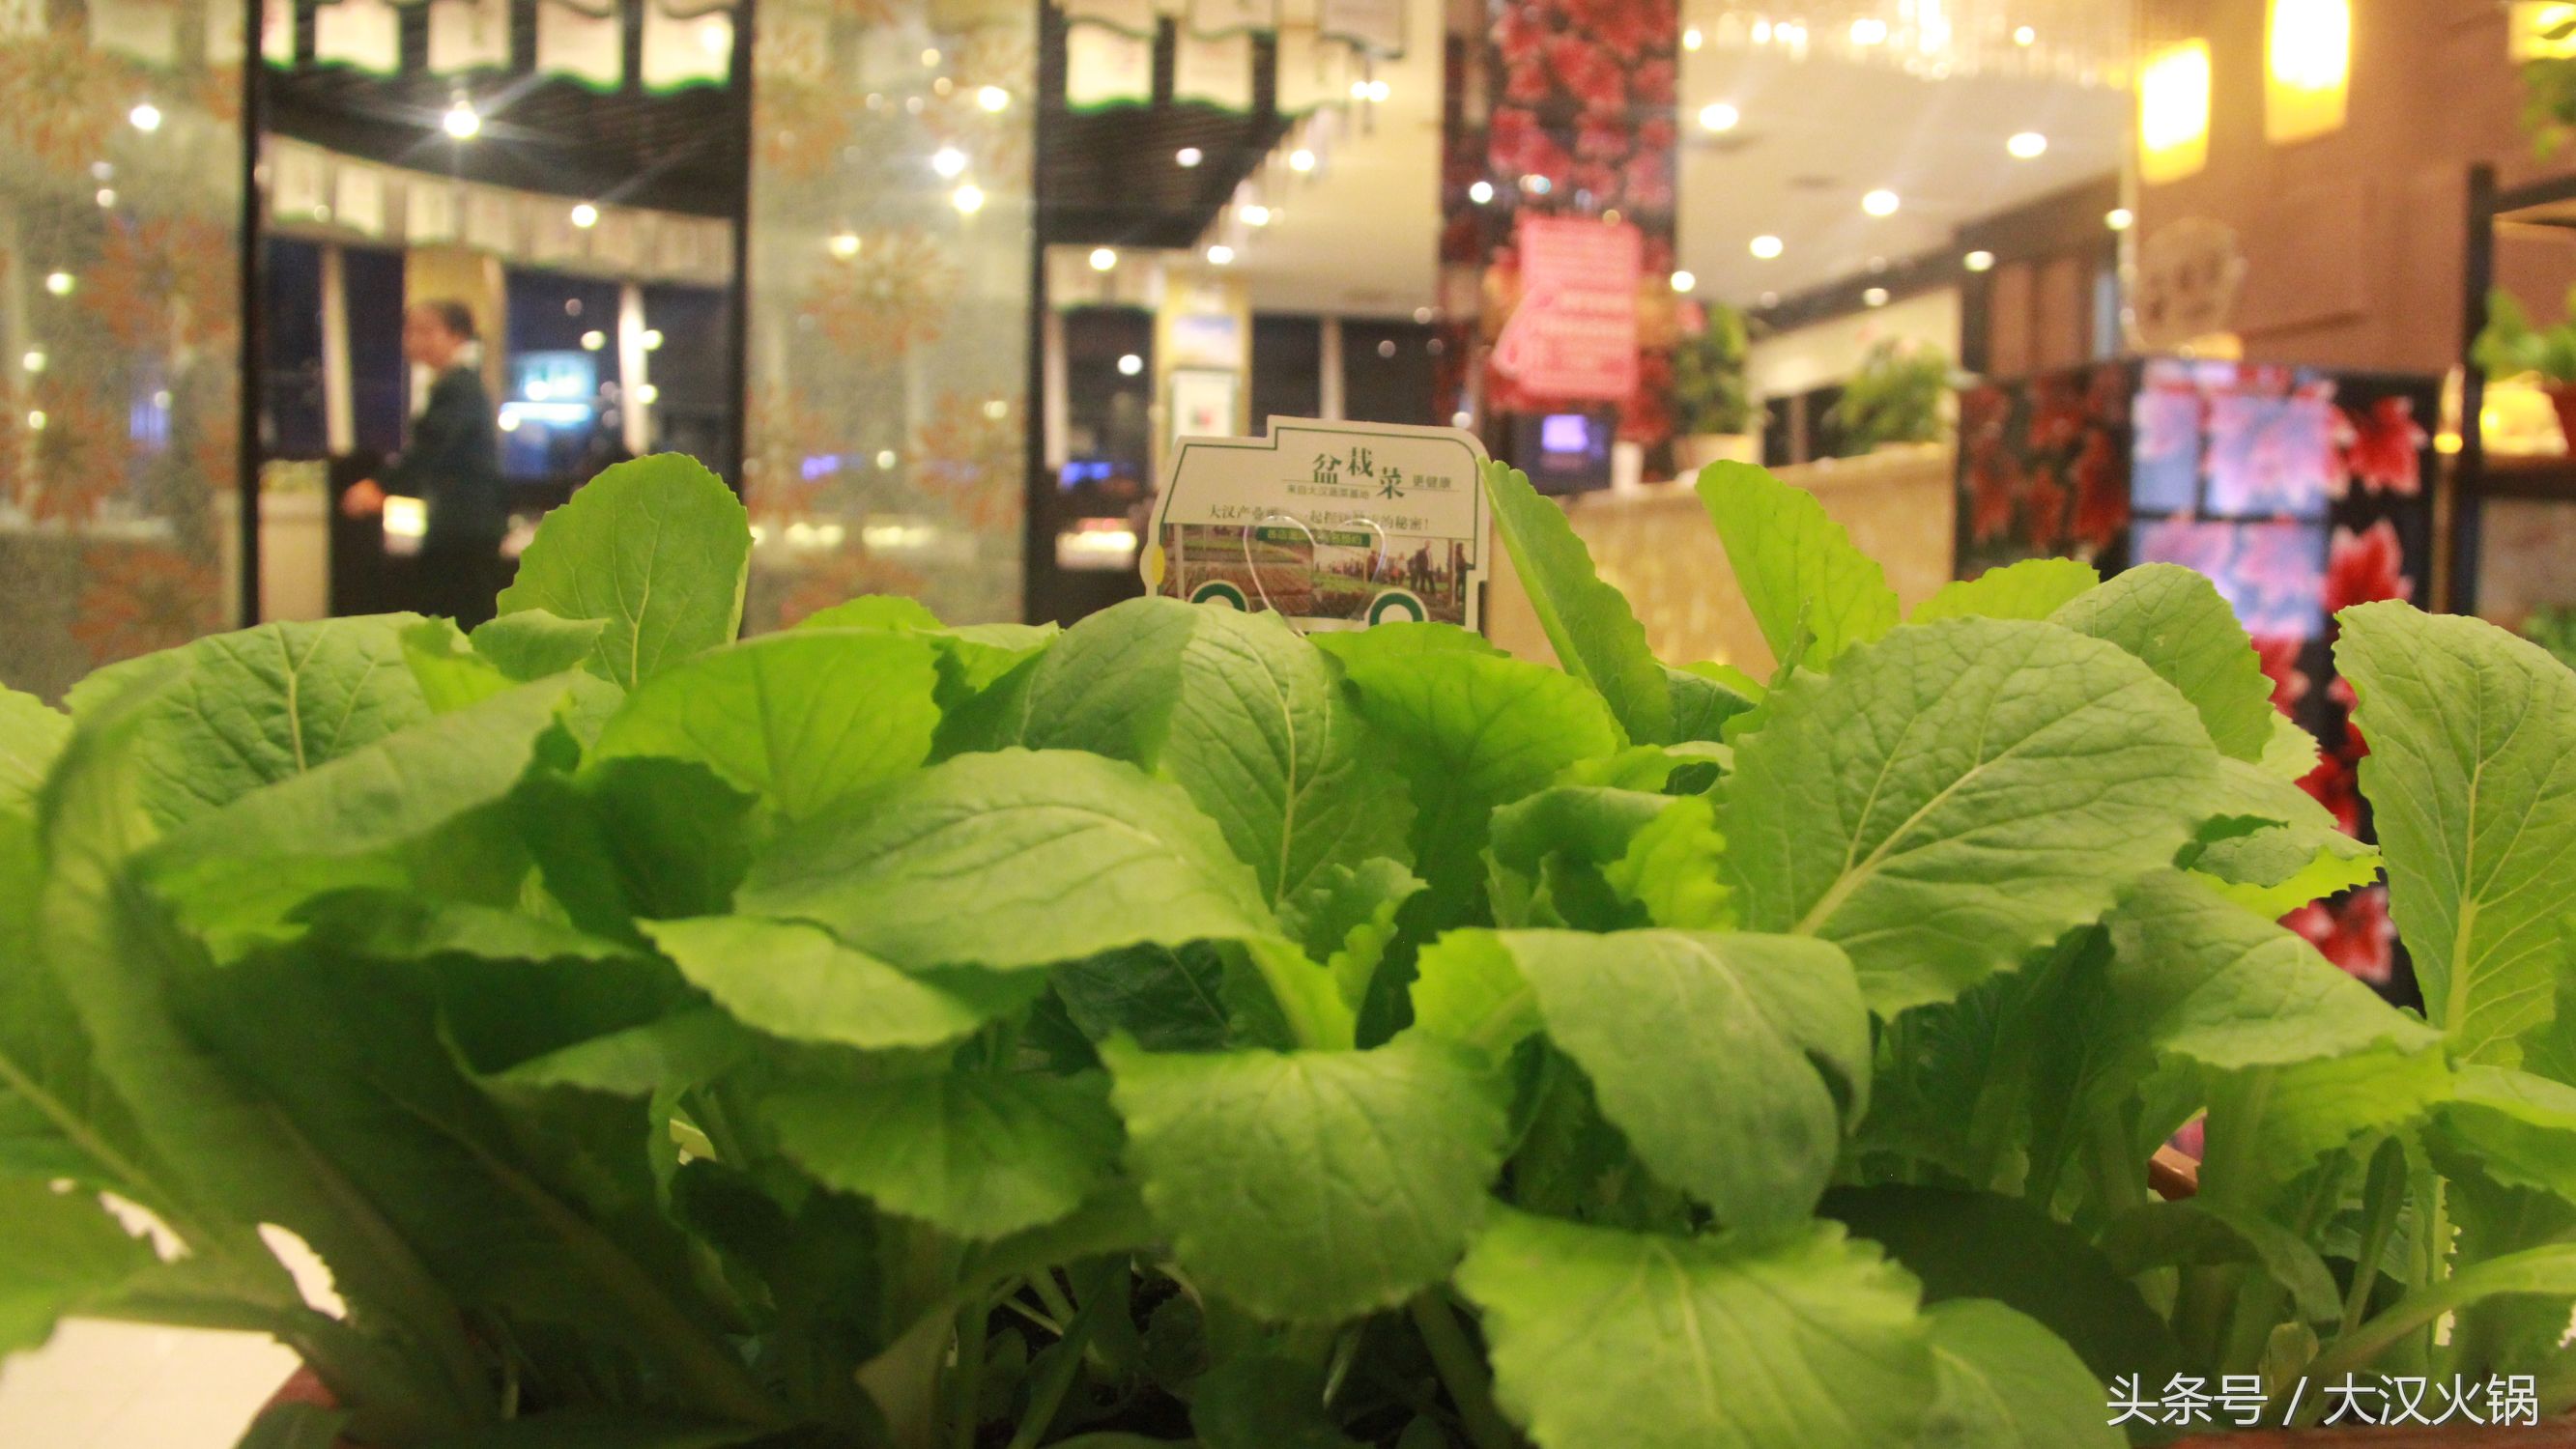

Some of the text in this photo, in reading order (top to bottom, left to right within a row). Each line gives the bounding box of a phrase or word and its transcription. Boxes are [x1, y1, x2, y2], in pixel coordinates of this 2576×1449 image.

[1313, 446, 1405, 499] 盆栽菜
[1413, 474, 1452, 488] 更健康
